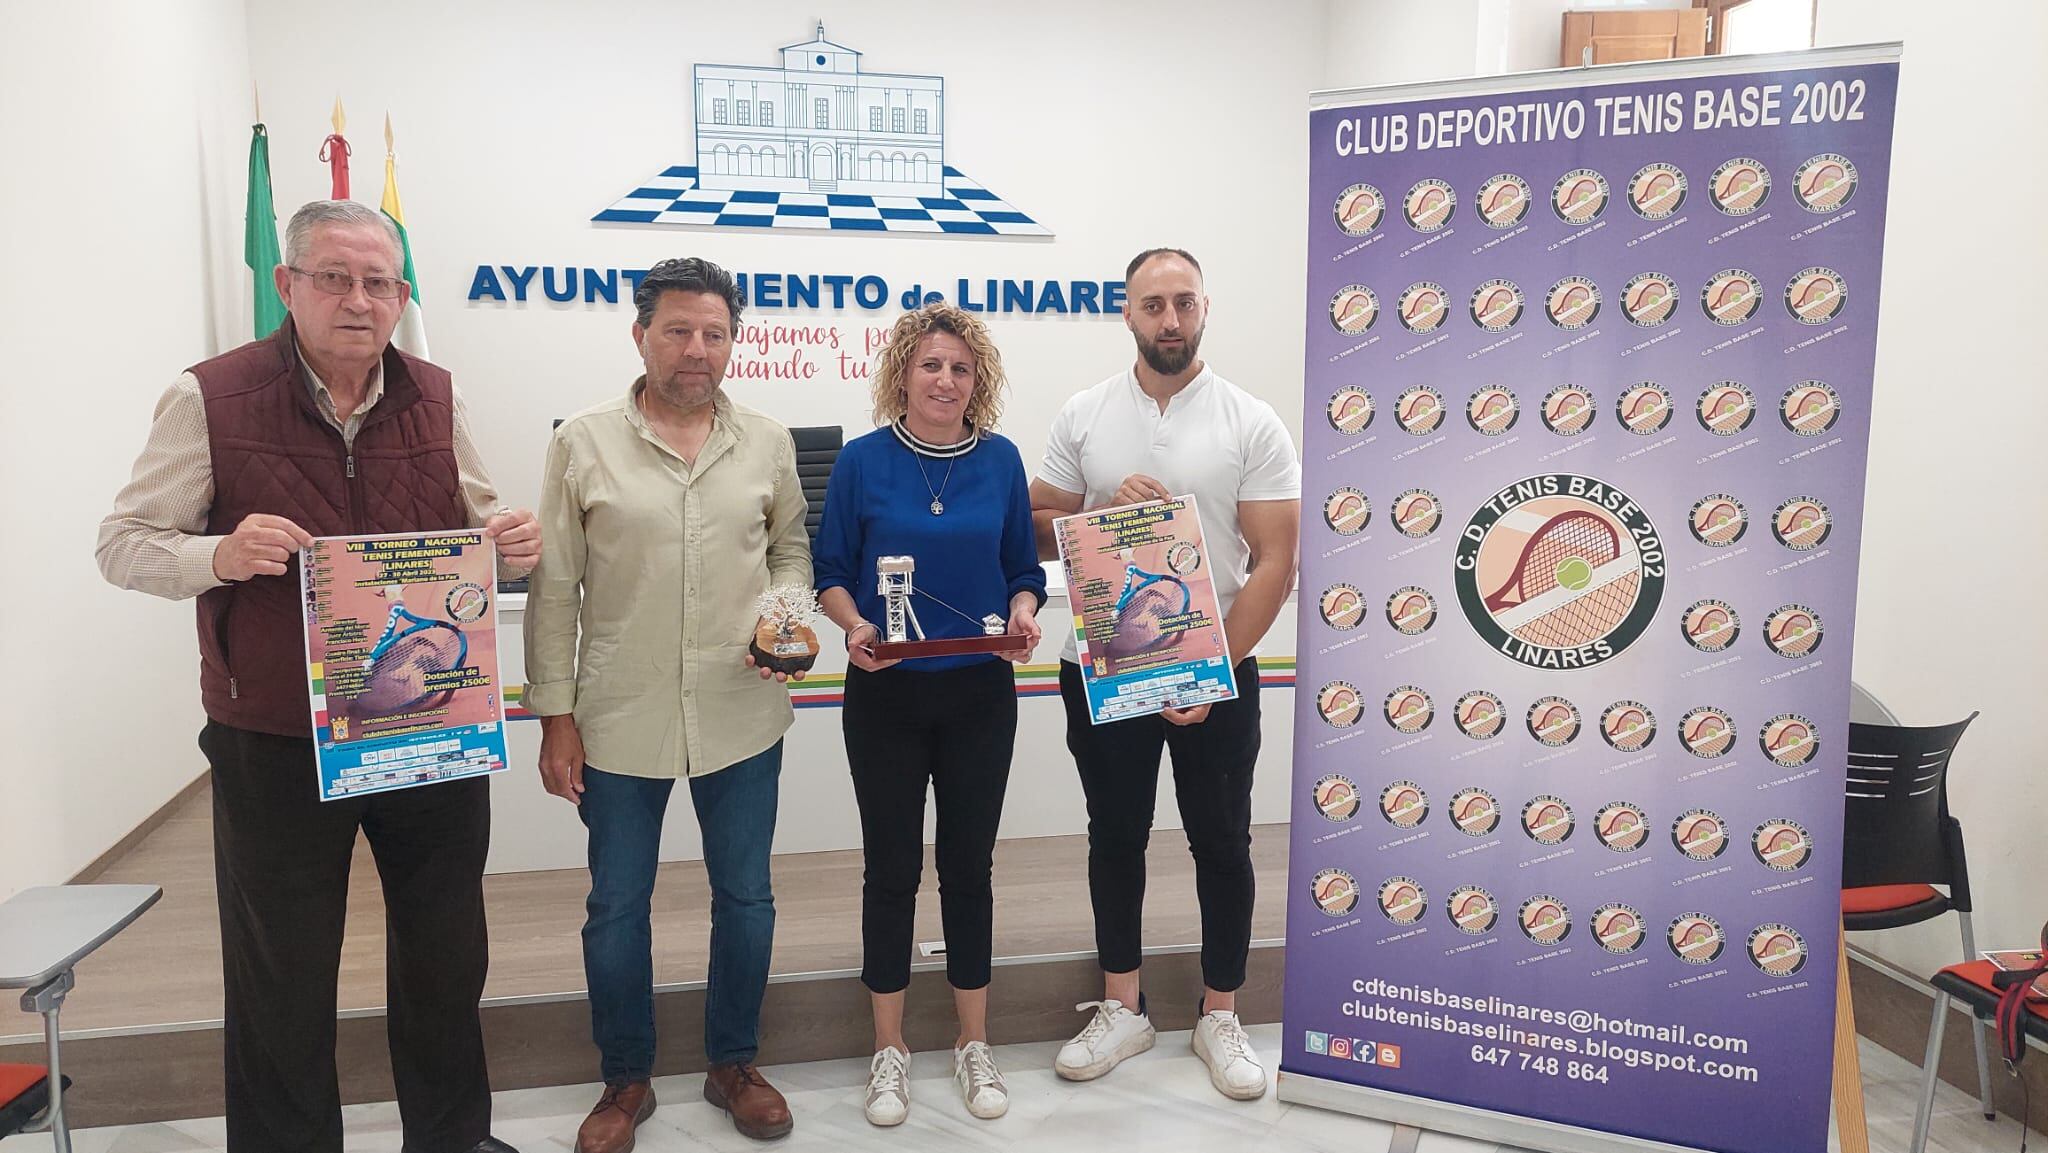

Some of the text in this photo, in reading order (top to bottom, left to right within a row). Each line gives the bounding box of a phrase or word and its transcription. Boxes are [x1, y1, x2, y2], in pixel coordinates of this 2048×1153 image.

[1335, 80, 1866, 157] CLUB DEPORTIVO TENIS BASE 2002
[467, 265, 1127, 314] AYUNTIENTO de LINARE
[835, 350, 872, 380] tu
[1100, 514, 1165, 531] TENIS FEMENINO
[1105, 510, 1138, 521] TORNEO
[1143, 503, 1184, 515] NACIONAL
[1456, 475, 1665, 578] C. D. TENIS BASE 2002
[346, 536, 480, 551] VIII TORNEO NACIONAL
[363, 549, 451, 561] TENIS FEMENINO
[1158, 614, 1191, 626] Dotación
[1160, 624, 1188, 636] premios
[1501, 636, 1613, 668] LINARES
[424, 668, 478, 681] Dotación de
[424, 675, 491, 693] premios 2500€
[1351, 977, 1748, 1054] cdtenisbaselinares@hotmail.com
[1342, 999, 1759, 1082] clubtenisbaselinares.blogspot.com
[1470, 1043, 1609, 1085] 647 748 864
